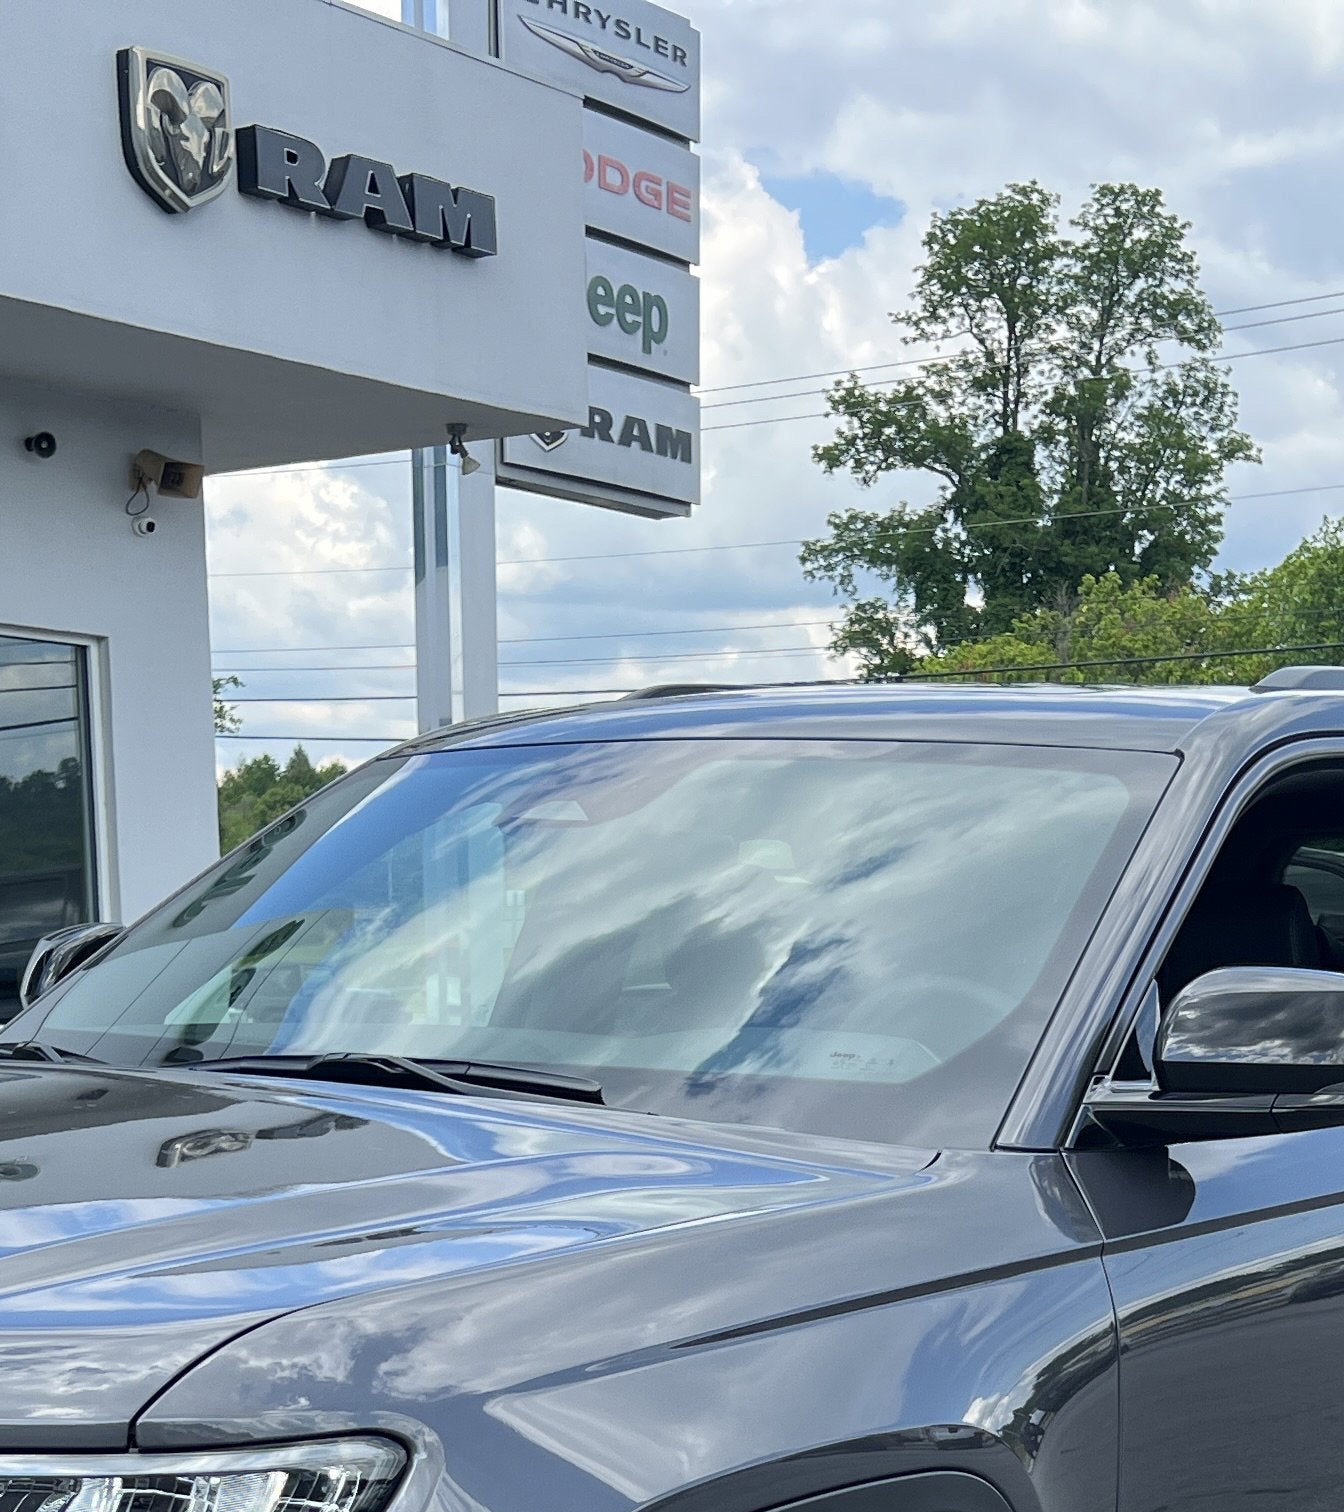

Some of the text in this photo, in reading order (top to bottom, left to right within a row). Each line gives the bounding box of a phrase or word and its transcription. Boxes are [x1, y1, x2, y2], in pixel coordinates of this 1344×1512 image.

[524, 0, 688, 67] HRYSLER
[235, 124, 498, 259] RAM
[581, 405, 692, 464] RAM
